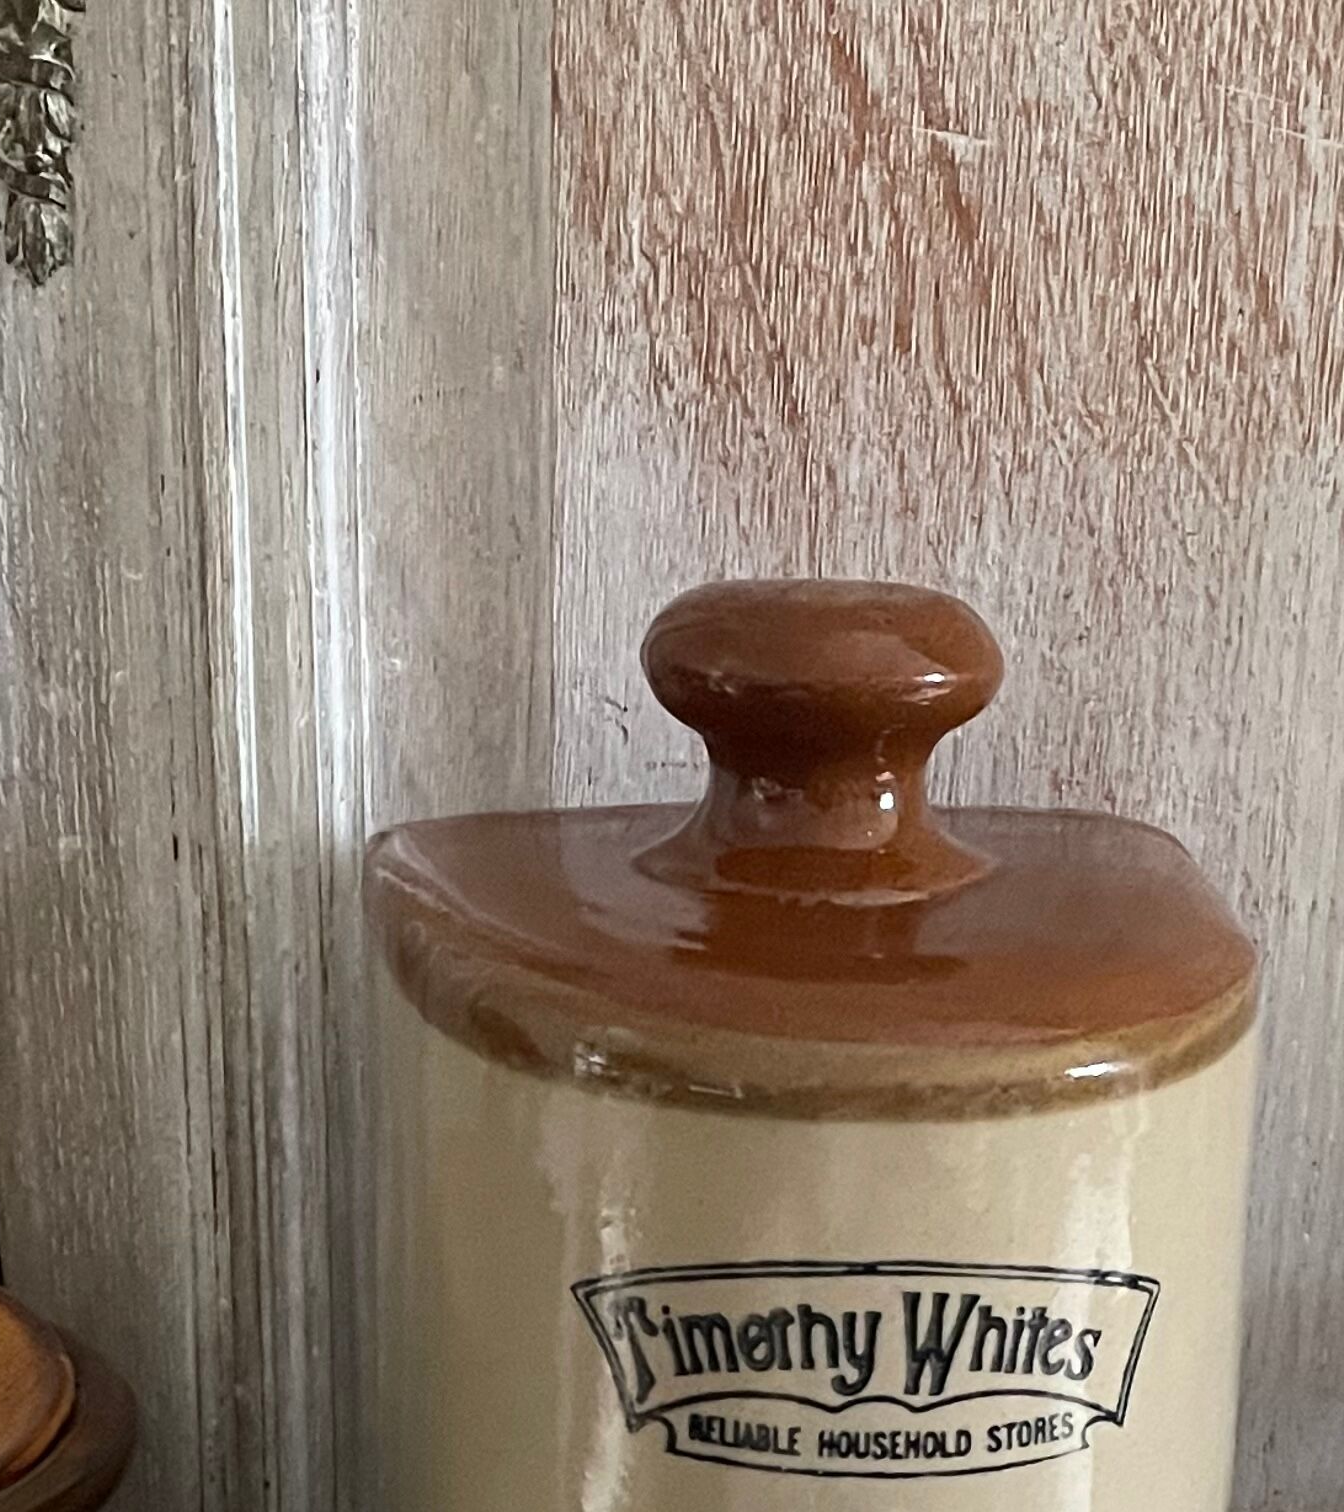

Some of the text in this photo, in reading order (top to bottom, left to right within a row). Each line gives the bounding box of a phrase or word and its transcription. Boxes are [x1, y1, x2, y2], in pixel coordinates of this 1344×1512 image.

[610, 1291, 1103, 1403] Timothy Whites
[688, 1412, 1074, 1459] RELIABLE HOUSEHOLD STORES
